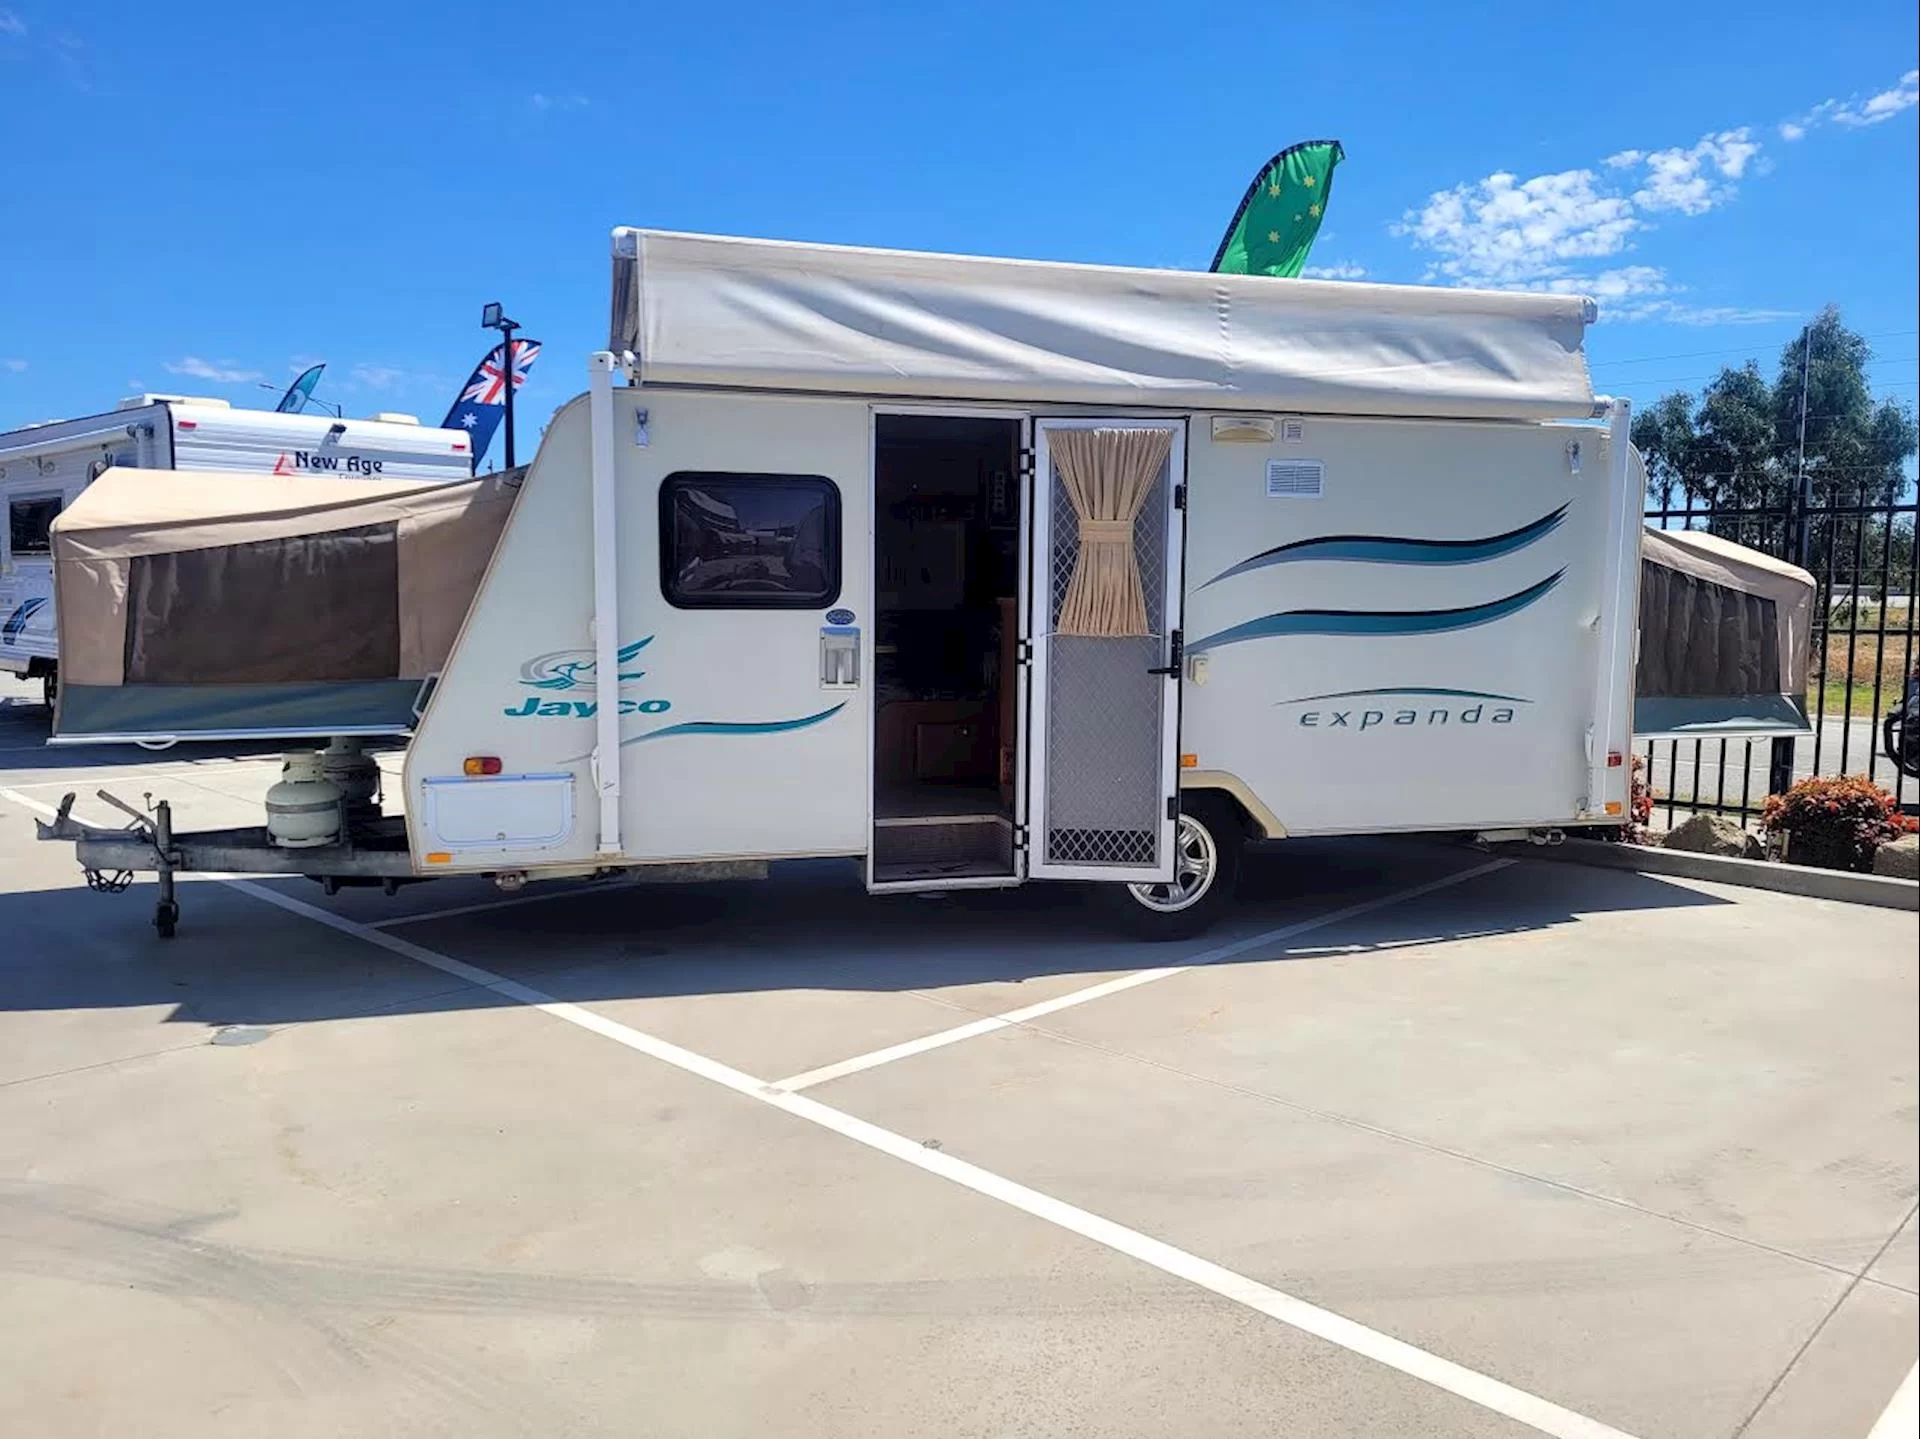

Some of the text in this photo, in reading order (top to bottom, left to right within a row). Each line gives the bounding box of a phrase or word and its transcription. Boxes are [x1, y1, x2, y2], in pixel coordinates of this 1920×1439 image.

[295, 451, 382, 475] New Age
[1299, 704, 1515, 731] expanda
